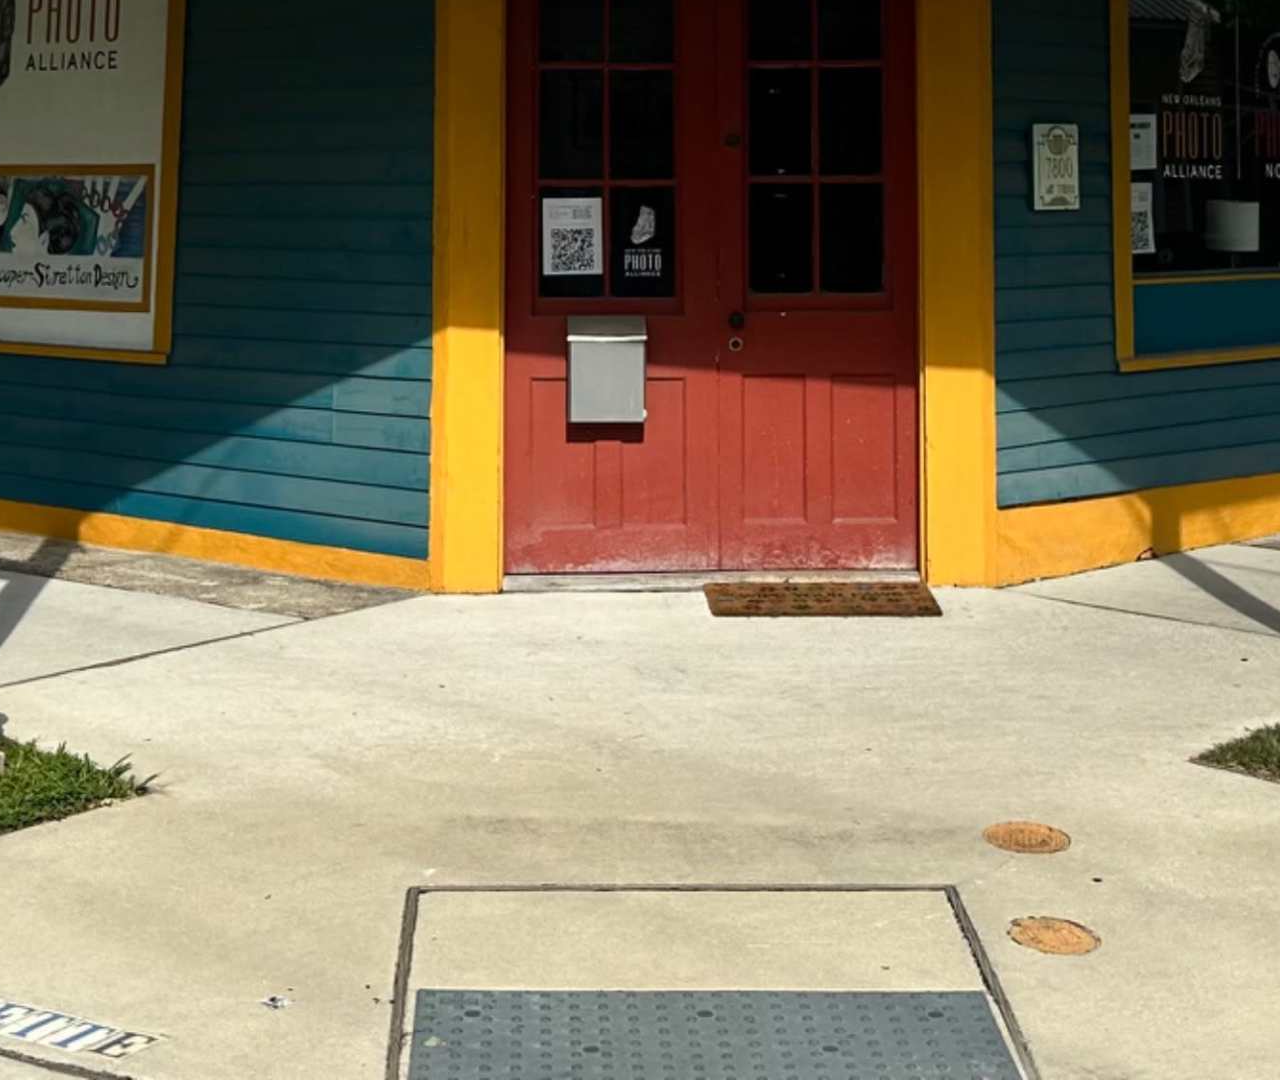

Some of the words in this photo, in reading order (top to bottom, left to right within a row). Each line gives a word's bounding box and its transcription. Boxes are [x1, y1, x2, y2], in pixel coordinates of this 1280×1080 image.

[25, 50, 118, 71] ALLIANCE
[1161, 93, 1181, 105] NEW
[1182, 94, 1222, 108] ORLEANS
[1162, 111, 1223, 160] PHOTO
[1162, 163, 1224, 180] ALLIANCE
[624, 254, 662, 270] PHOTO
